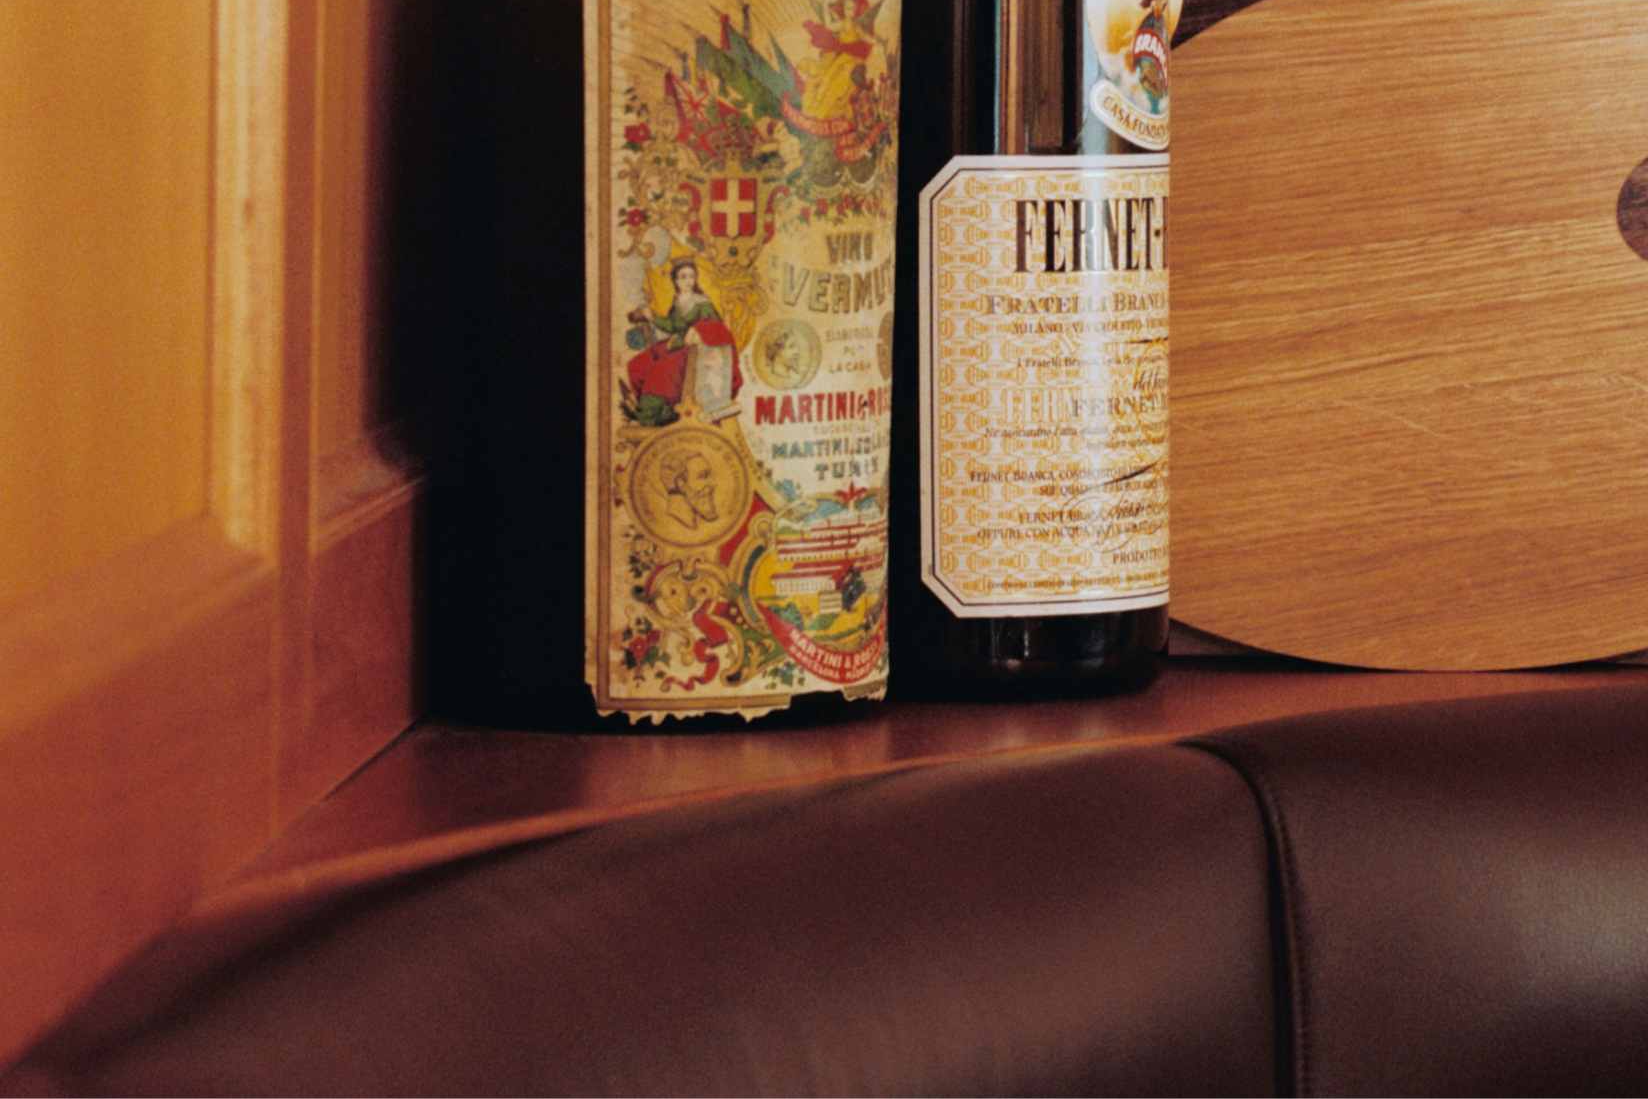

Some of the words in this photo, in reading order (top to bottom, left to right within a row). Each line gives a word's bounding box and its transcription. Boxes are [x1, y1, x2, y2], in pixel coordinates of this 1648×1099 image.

[1102, 96, 1131, 129] CASA
[985, 295, 1107, 315] FRATELLI
[1012, 322, 1064, 334] MILANO
[755, 390, 855, 425] MARTINI
[977, 527, 1022, 540] OPPURE
[1024, 526, 1050, 539] CON
[789, 628, 842, 669] MARTINI
